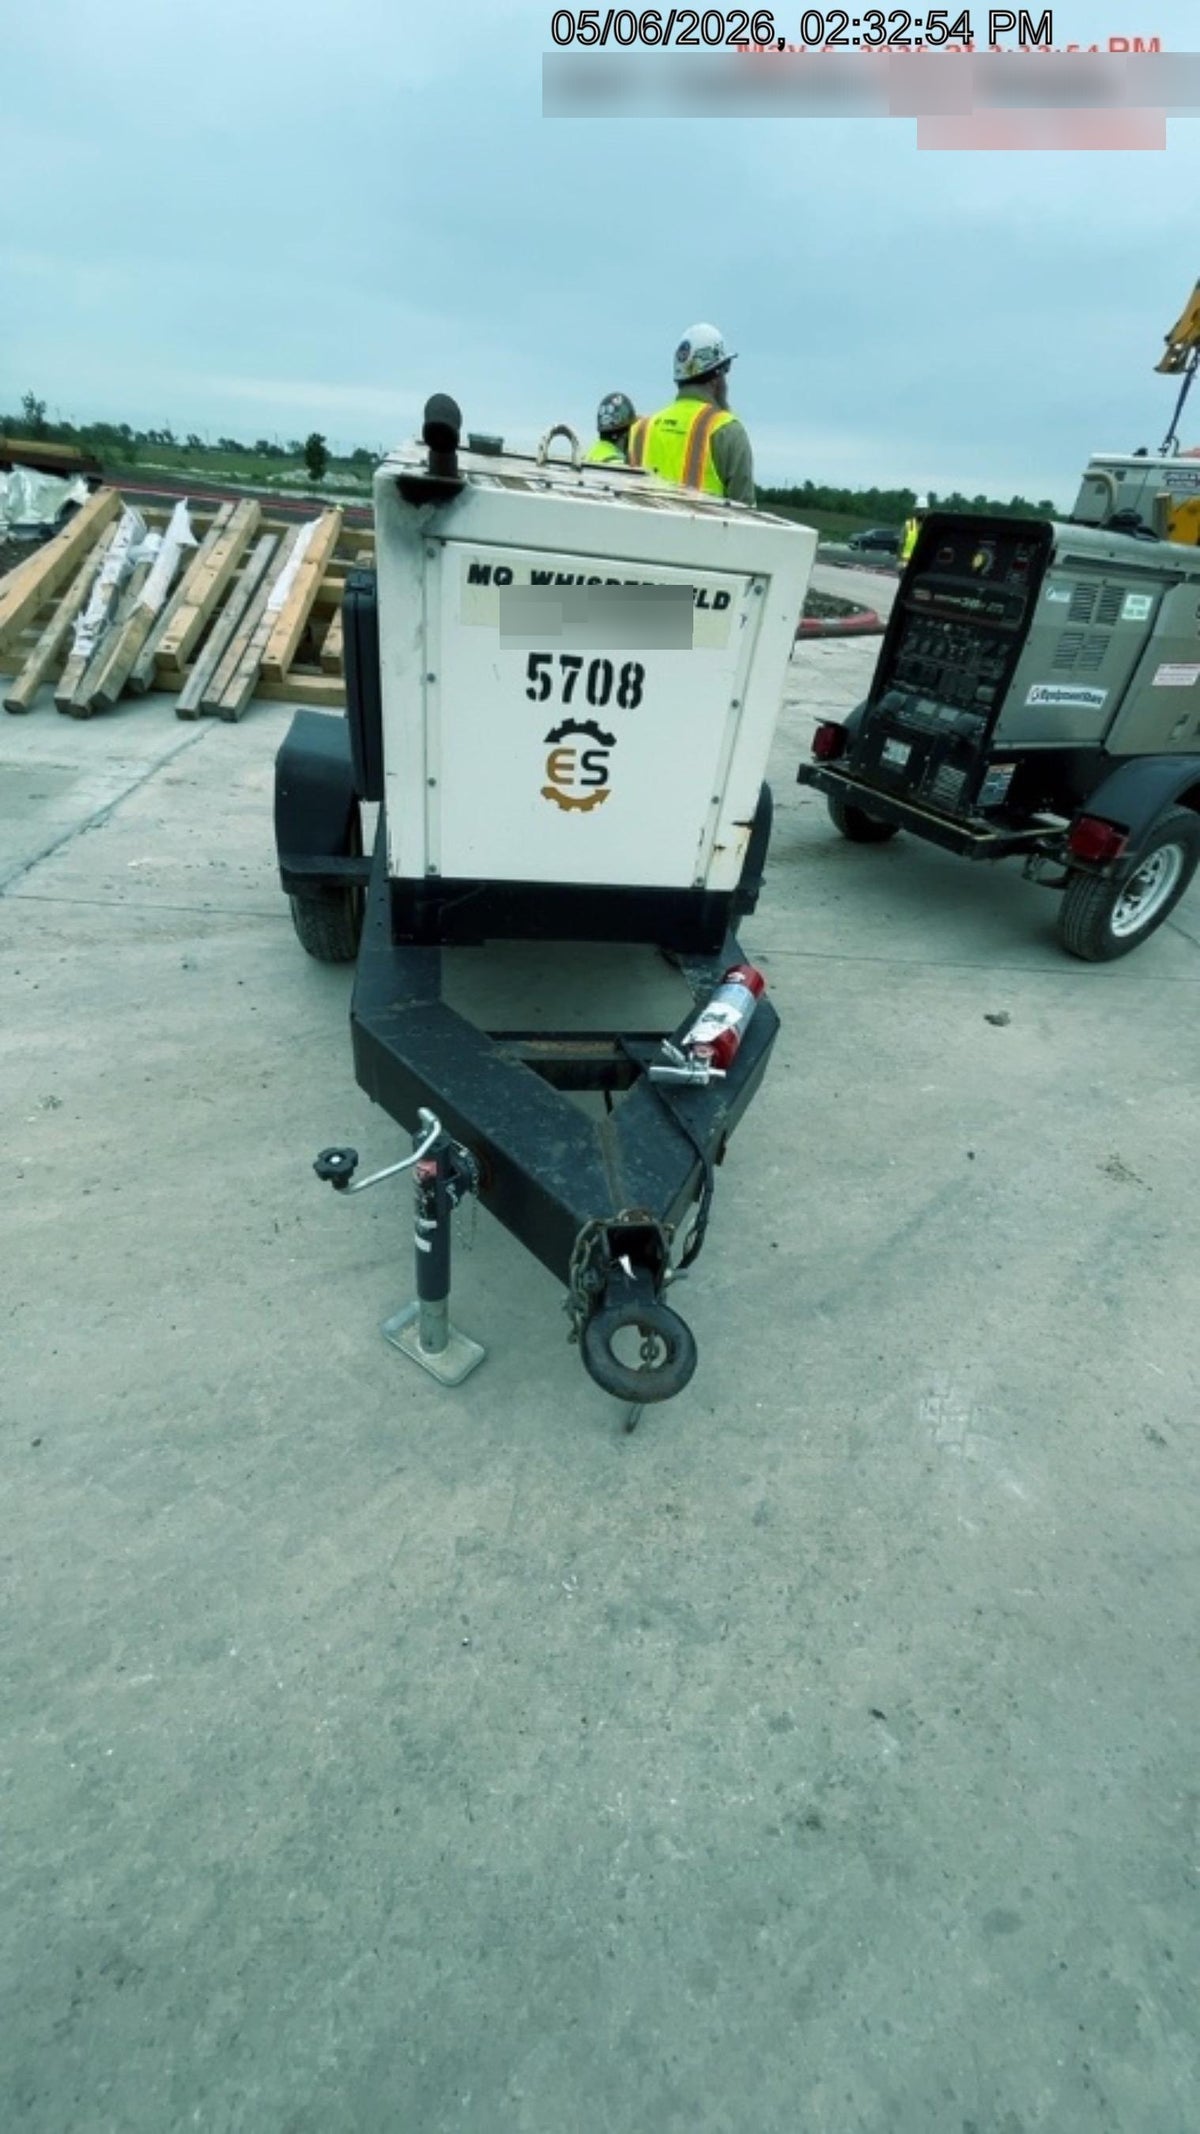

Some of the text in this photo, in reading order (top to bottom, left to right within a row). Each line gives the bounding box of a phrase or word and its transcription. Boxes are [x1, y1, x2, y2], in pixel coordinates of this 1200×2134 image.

[467, 563, 513, 586] MQ
[526, 653, 645, 709] 5708
[546, 748, 610, 785] ES
